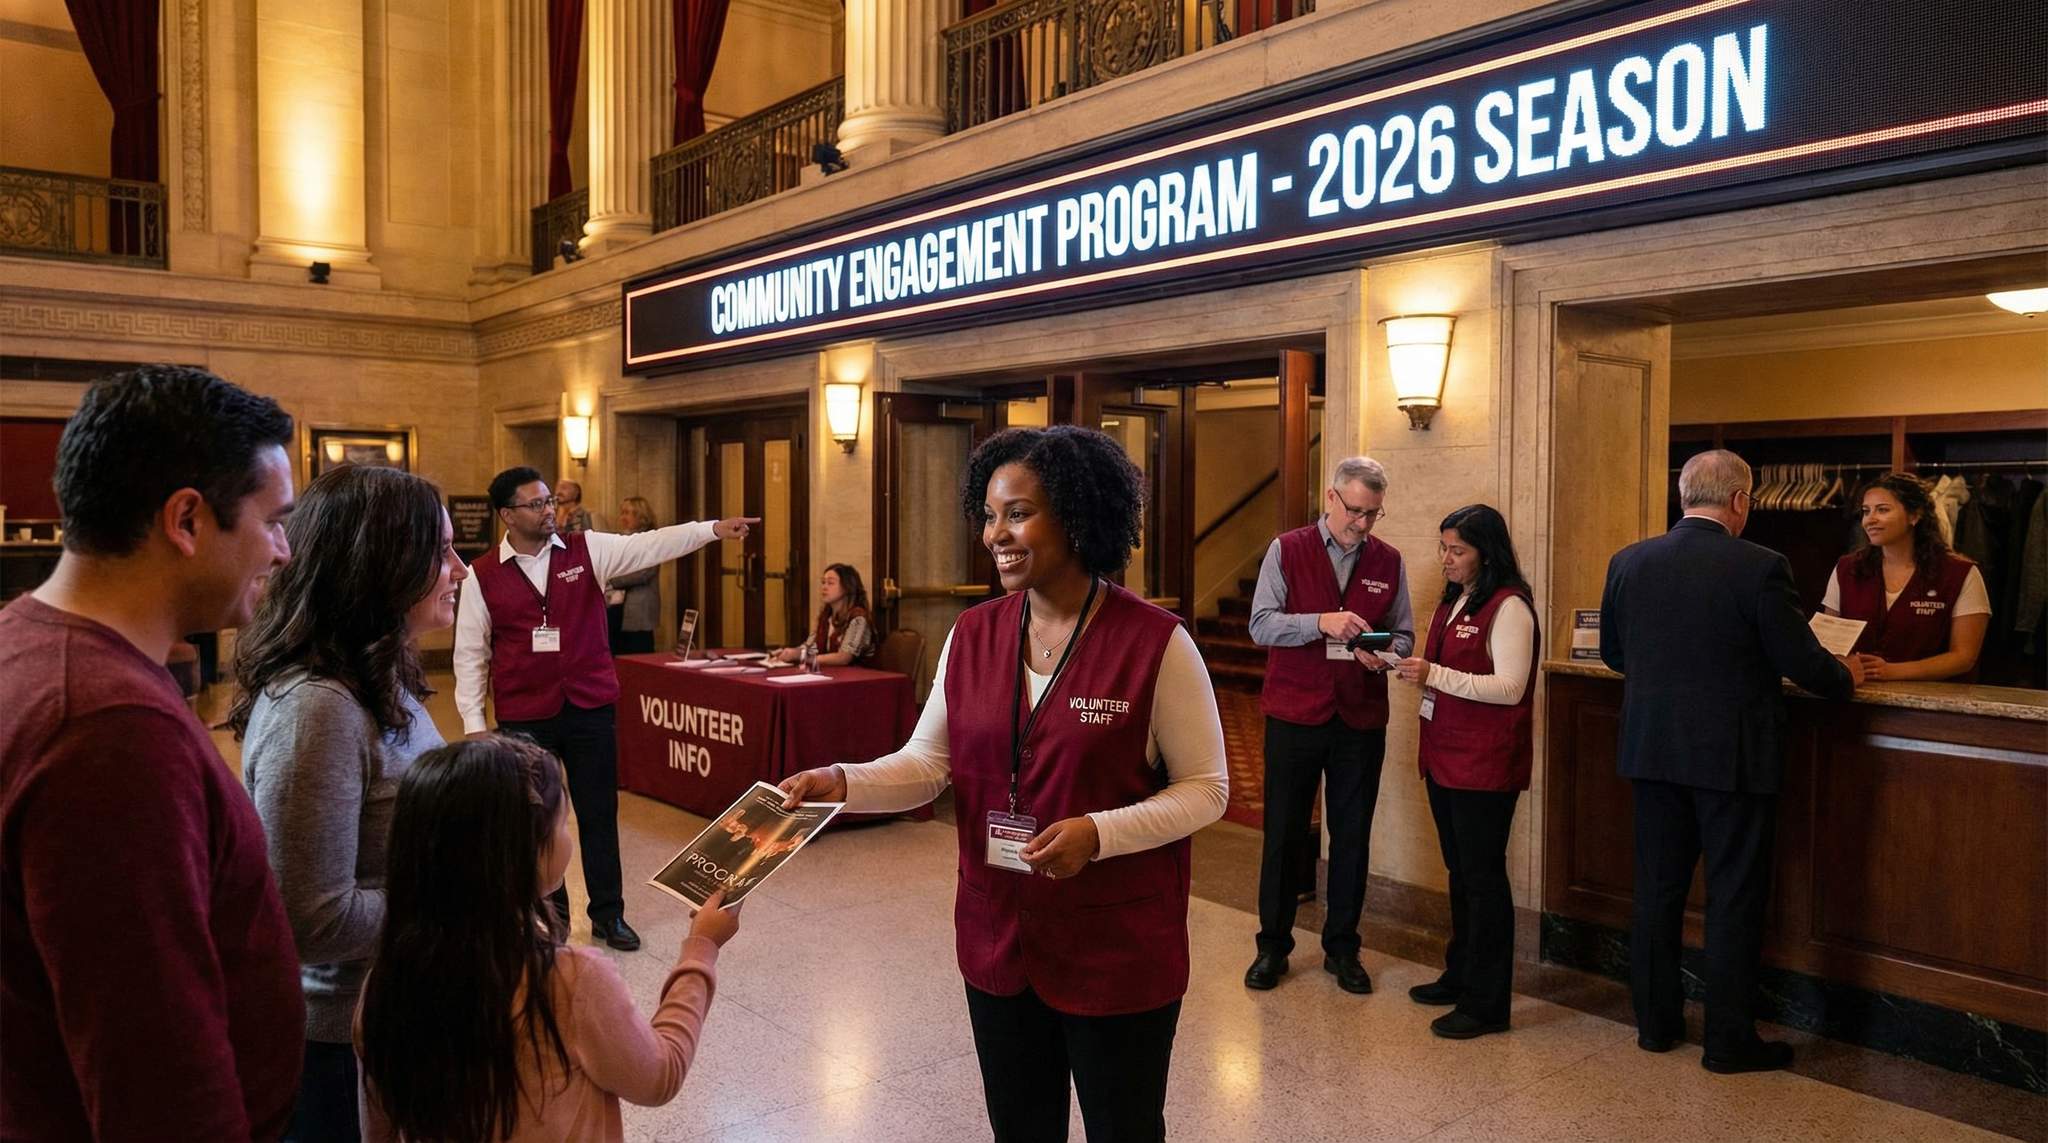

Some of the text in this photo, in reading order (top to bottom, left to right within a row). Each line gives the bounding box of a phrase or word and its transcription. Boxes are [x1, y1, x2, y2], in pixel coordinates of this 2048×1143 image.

[711, 24, 1769, 334] COMMUNITY ENGAGEMENT PROGRAM - 2026 SEASON
[640, 694, 744, 746] VOLUNTEER
[1069, 697, 1130, 713] VOLUNTEER
[1080, 711, 1113, 725] STAFF
[669, 739, 711, 778] INFO
